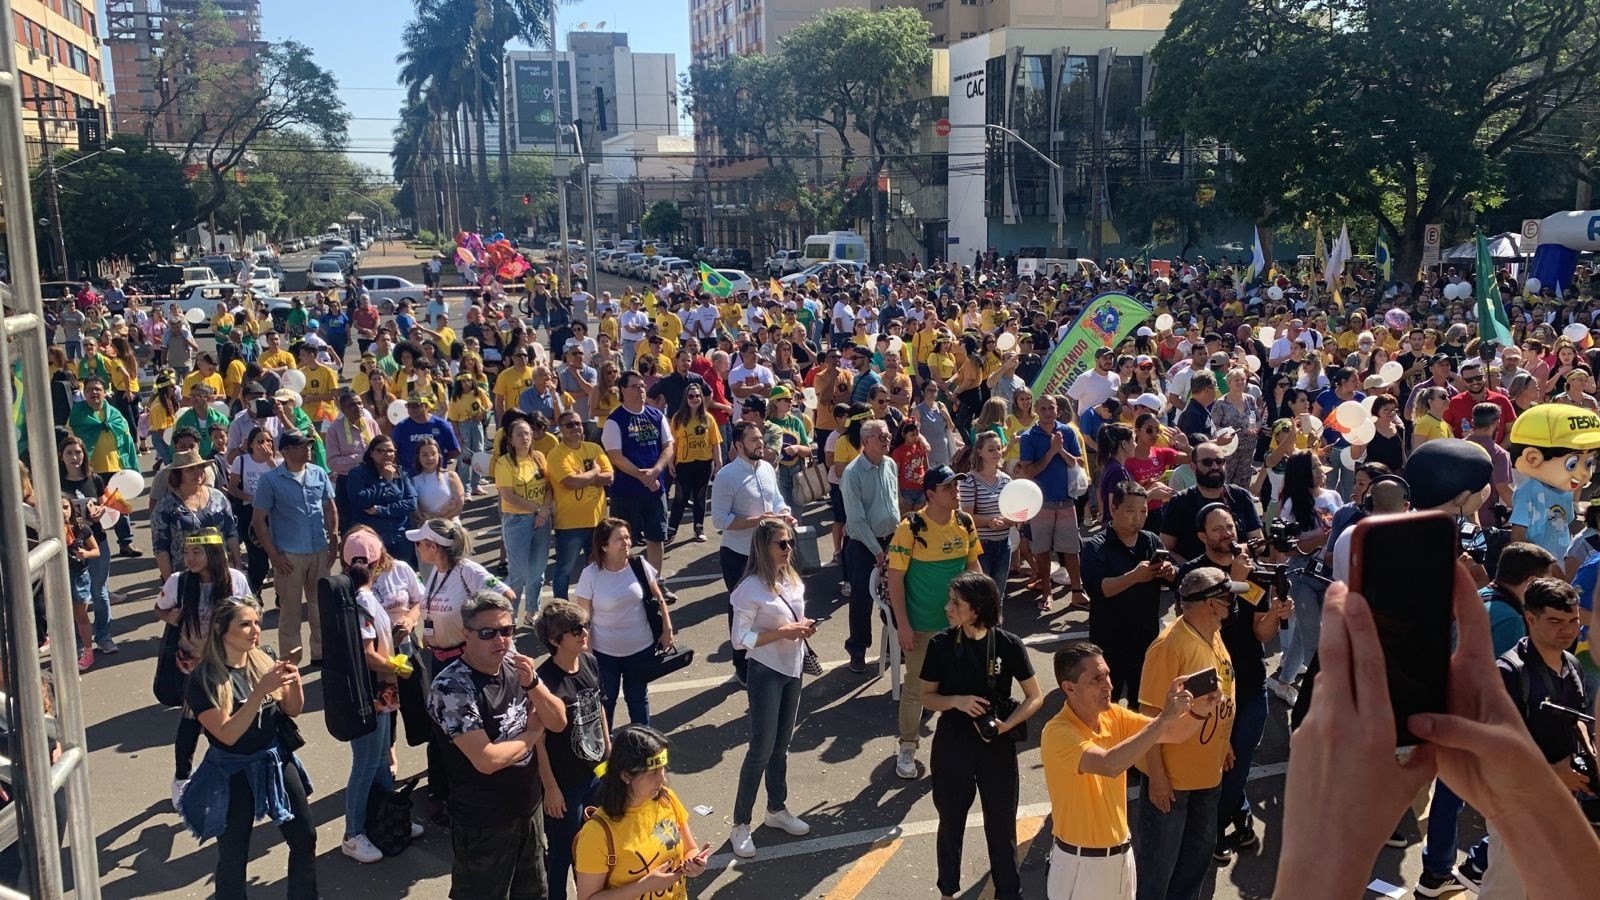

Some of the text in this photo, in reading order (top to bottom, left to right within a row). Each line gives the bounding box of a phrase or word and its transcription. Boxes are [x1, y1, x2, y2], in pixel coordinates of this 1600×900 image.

[966, 79, 984, 98] CAC
[1429, 230, 1435, 240] E
[1526, 224, 1533, 235] E
[1567, 415, 1600, 430] JESUS
